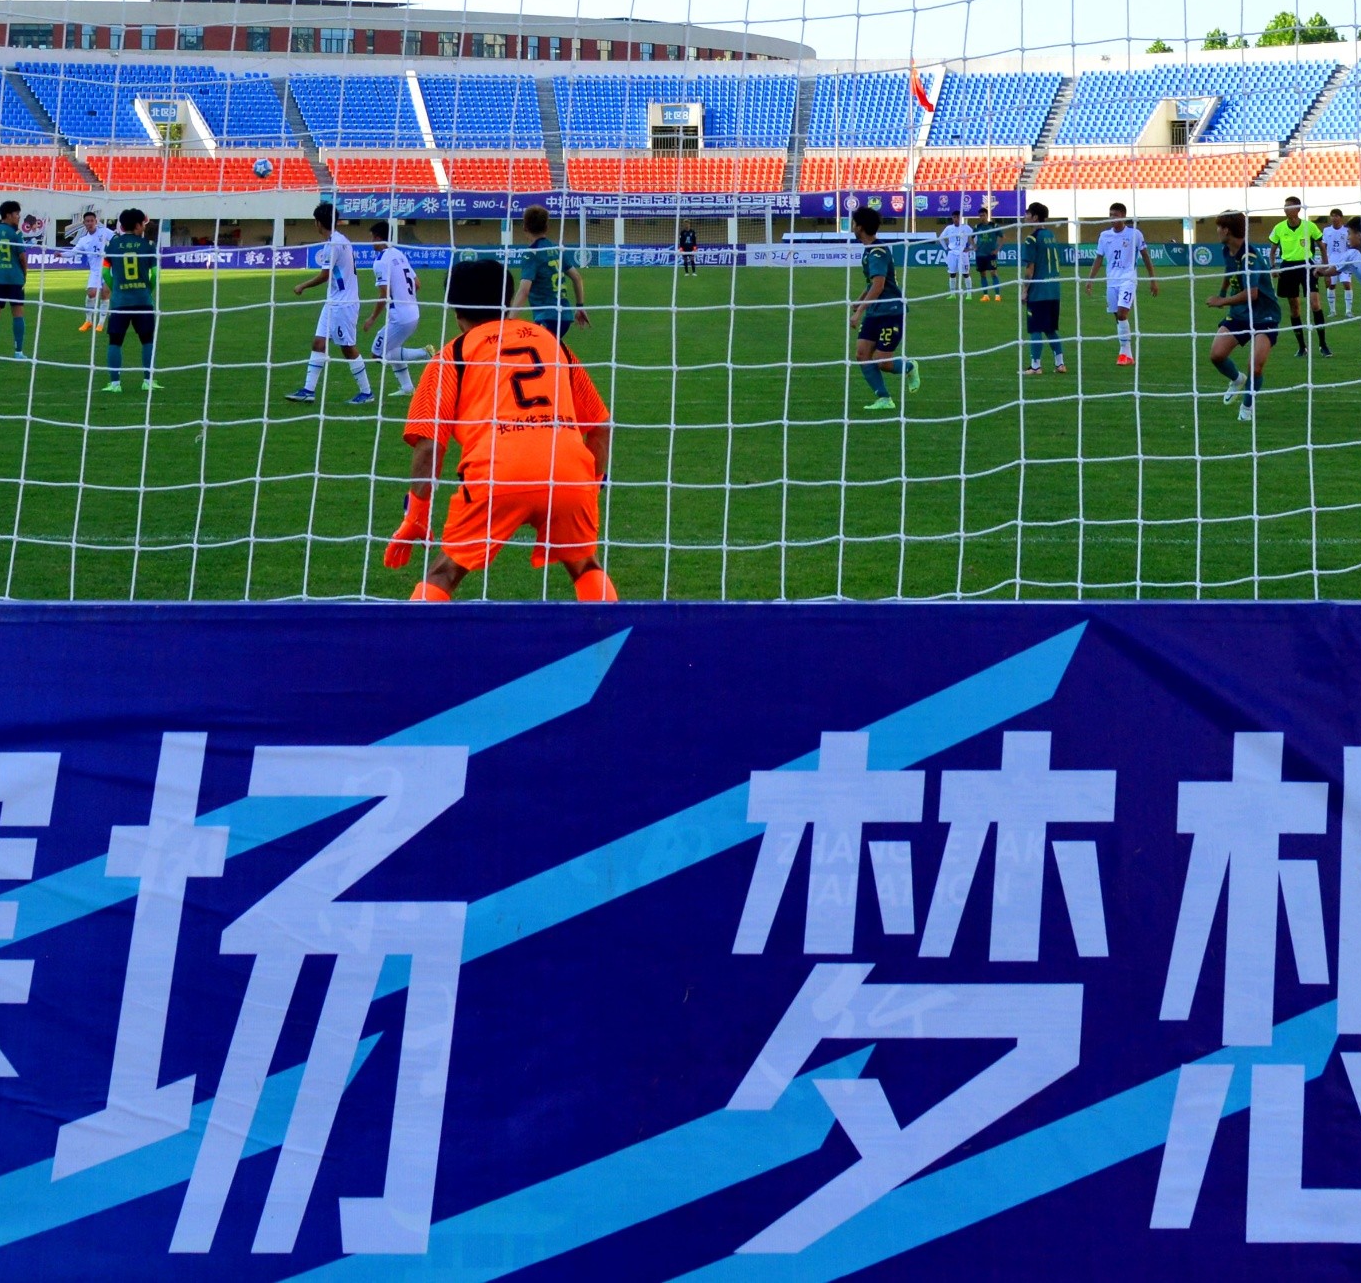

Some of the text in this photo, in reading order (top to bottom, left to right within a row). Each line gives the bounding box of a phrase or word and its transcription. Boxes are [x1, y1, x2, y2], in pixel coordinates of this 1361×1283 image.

[663, 111, 689, 120] 北区8
[343, 198, 377, 213] 冠军赛场
[1046, 247, 1060, 274] 11
[1113, 250, 1122, 260] 21
[123, 251, 139, 280] 8
[402, 268, 414, 296] 5
[1122, 291, 1133, 302] 21
[337, 325, 344, 338] 6
[879, 328, 893, 341] 22
[375, 336, 384, 348] 5
[500, 346, 552, 408] 2
